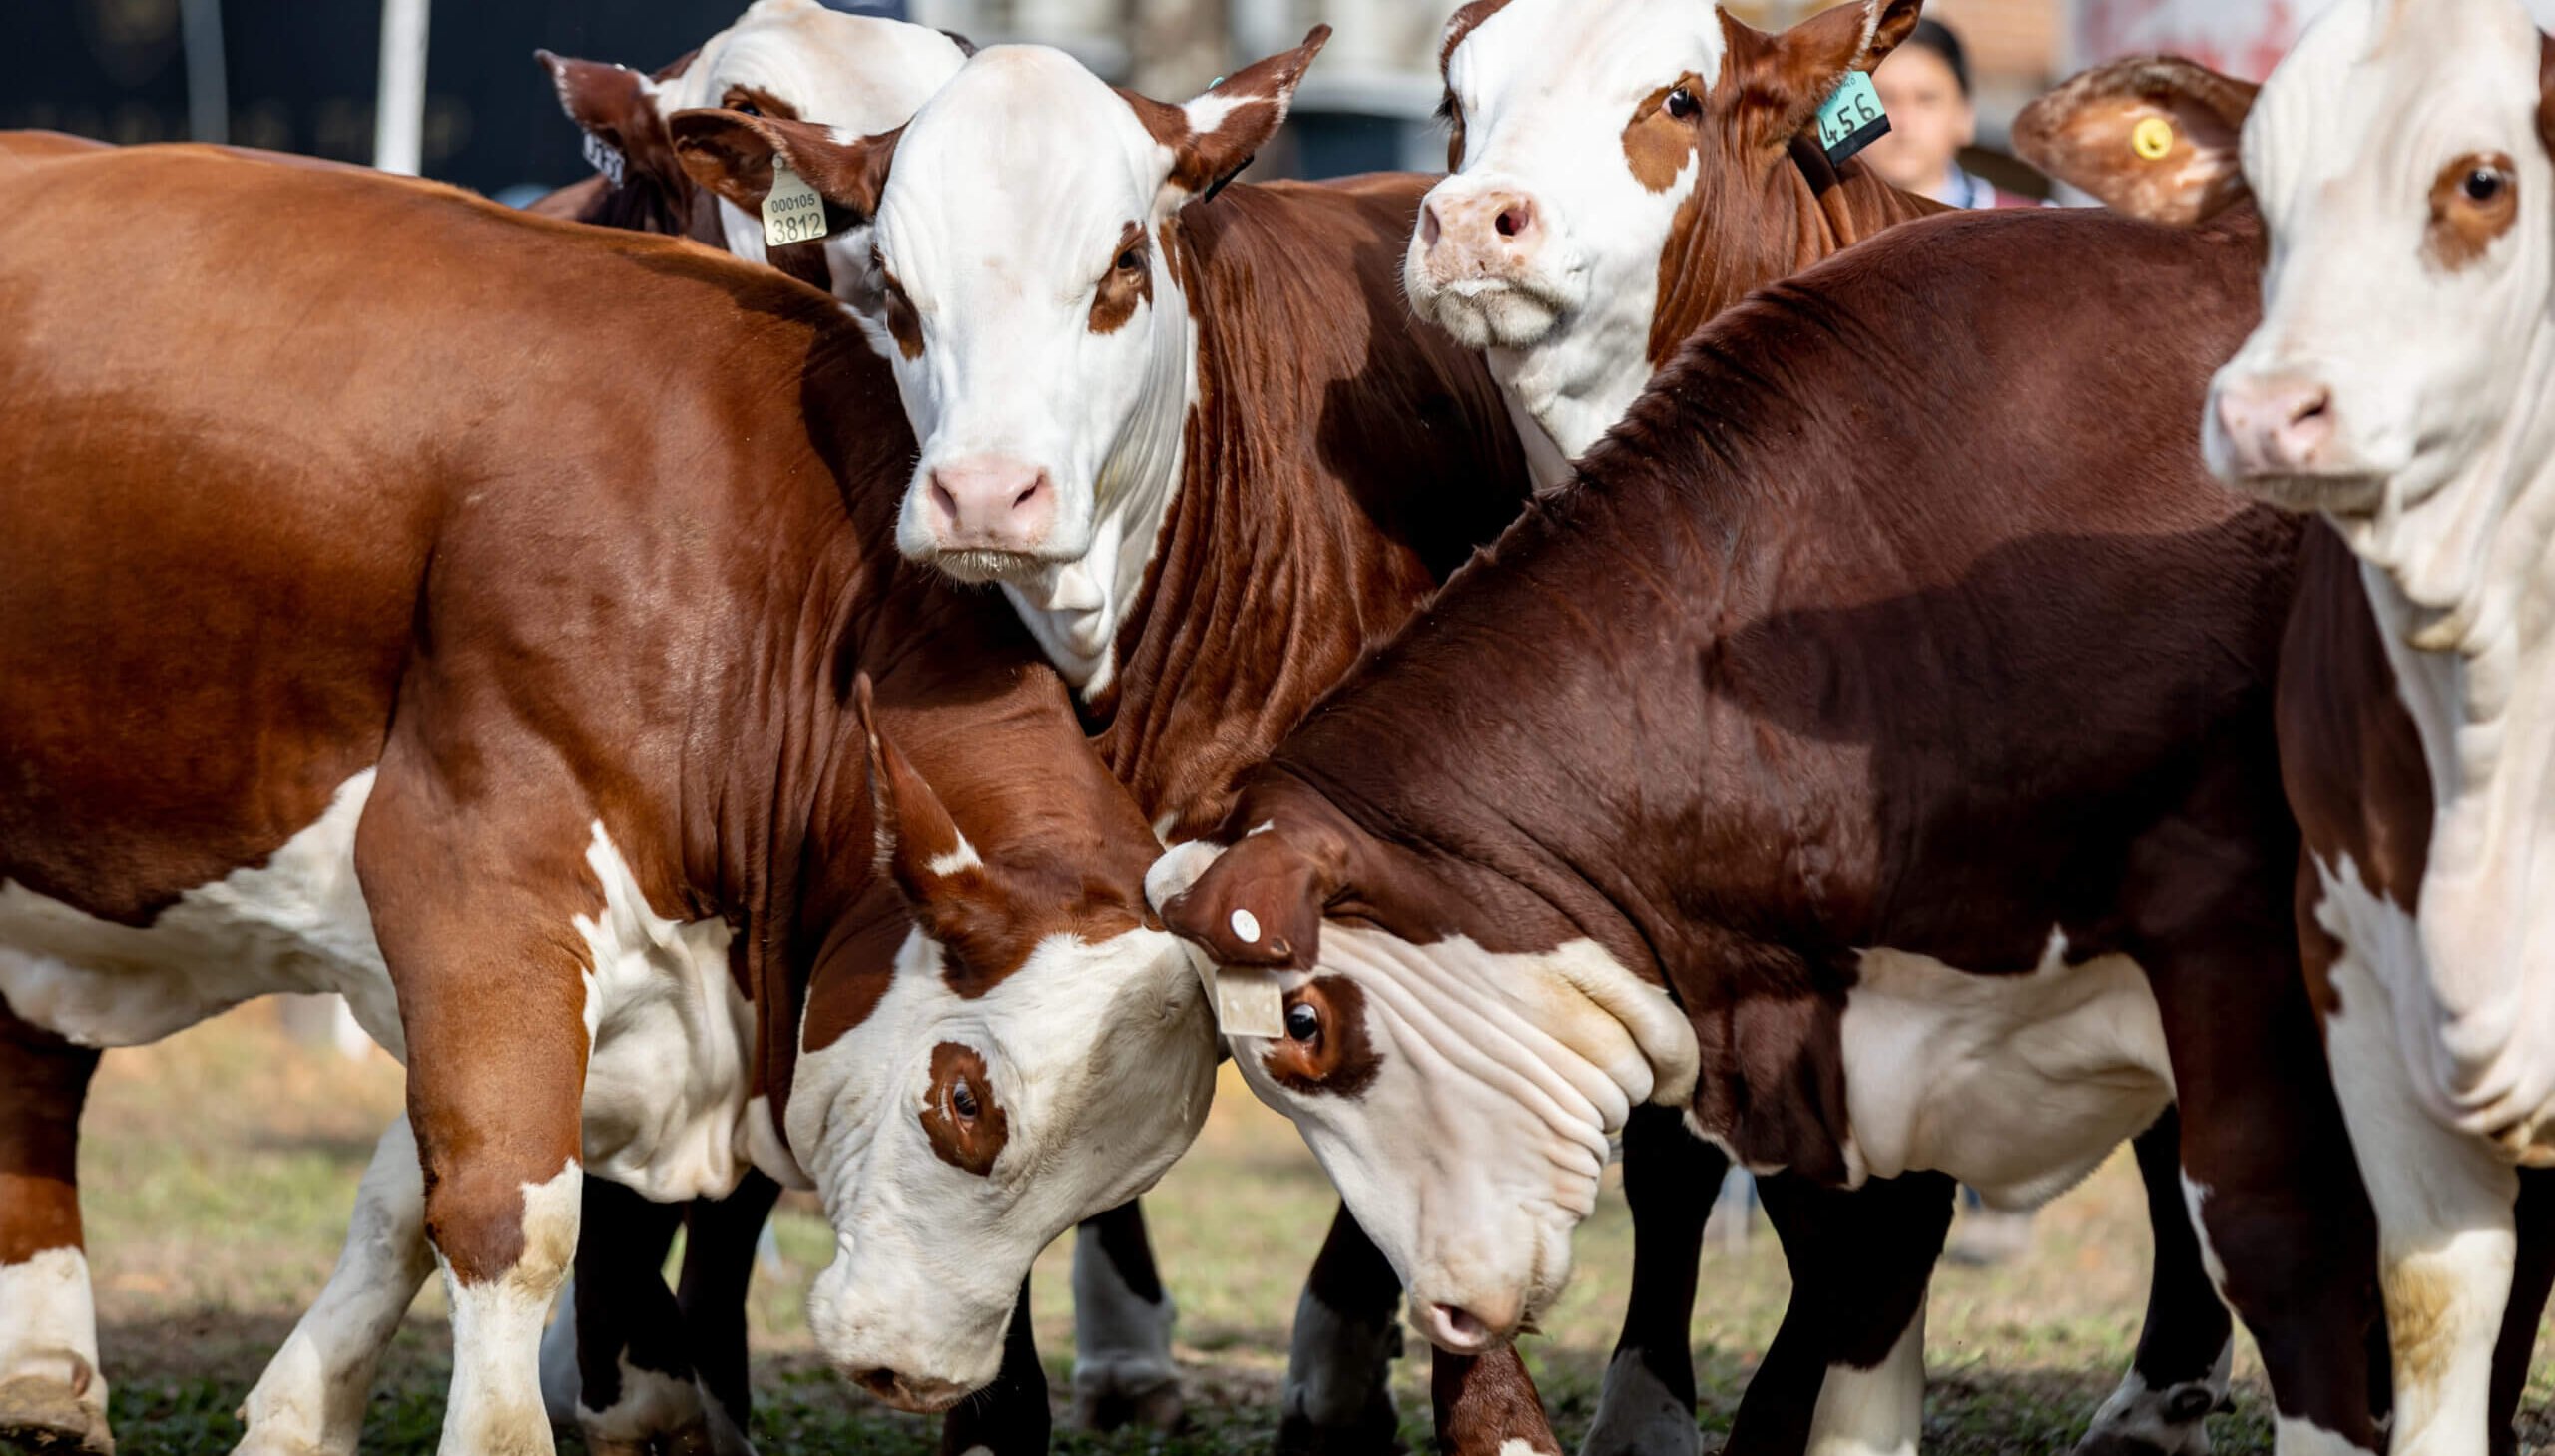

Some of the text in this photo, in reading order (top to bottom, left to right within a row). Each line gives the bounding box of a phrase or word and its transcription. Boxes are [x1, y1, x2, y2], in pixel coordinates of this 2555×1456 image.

[1821, 94, 1875, 142] 456
[771, 194, 815, 213] 000105
[773, 213, 822, 243] 3812
